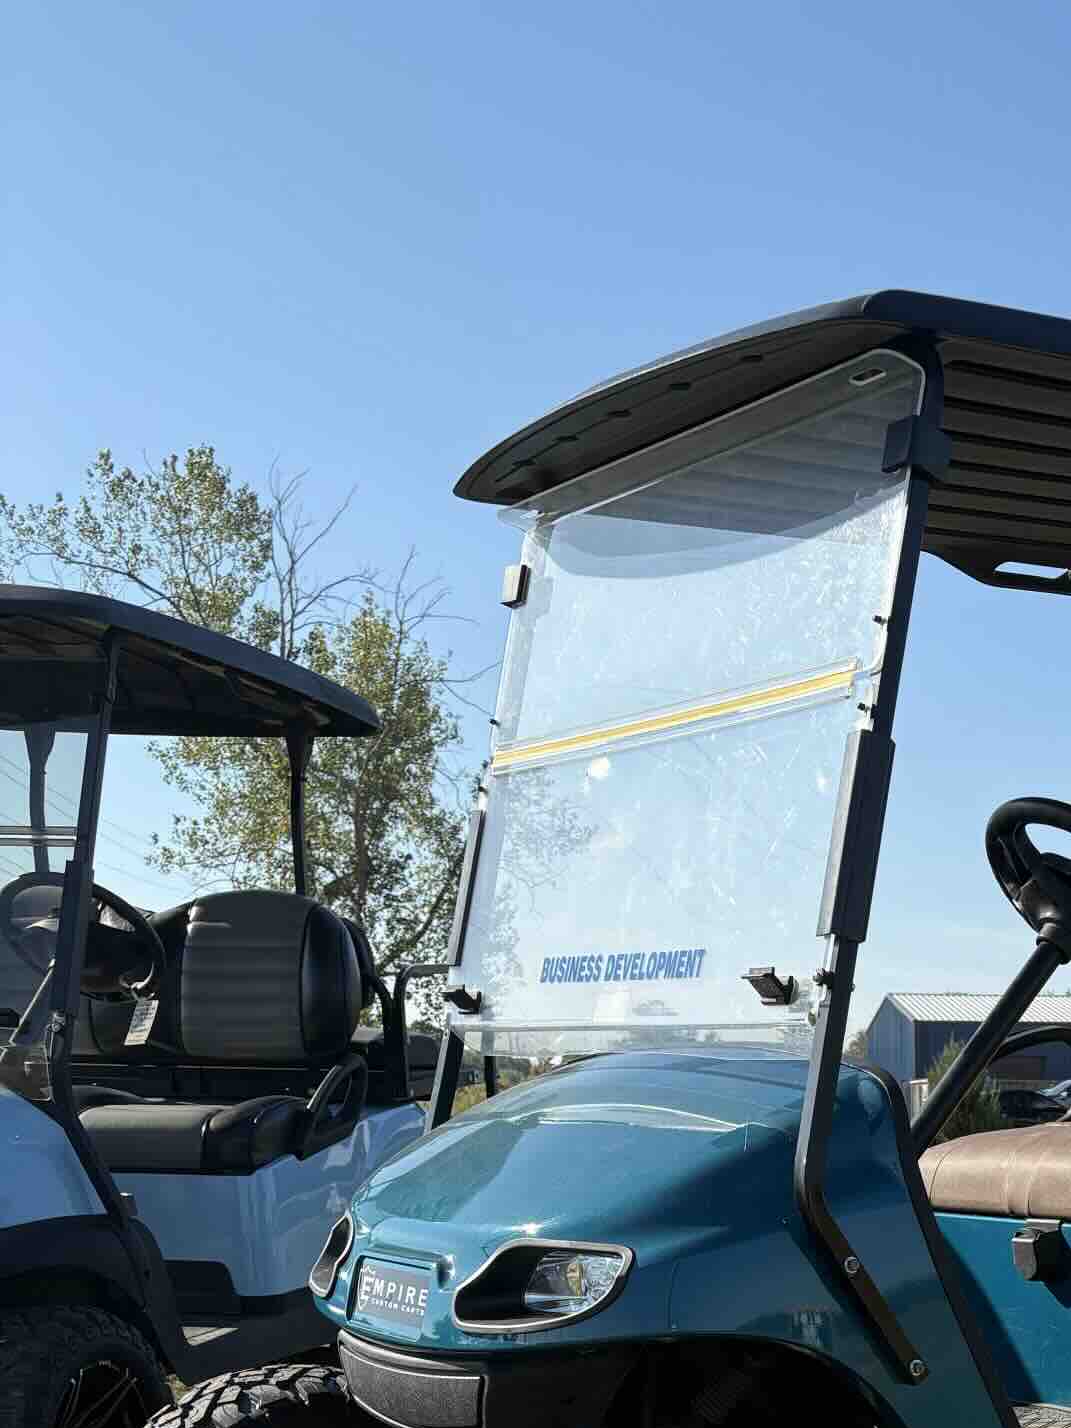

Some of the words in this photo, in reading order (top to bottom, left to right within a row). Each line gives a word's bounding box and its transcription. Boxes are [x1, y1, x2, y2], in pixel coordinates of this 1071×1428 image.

[540, 954, 604, 984] BUSINESS
[603, 949, 707, 982] DEVELOPMENT
[360, 1275, 429, 1307] EMPIRE
[371, 1297, 398, 1309] CUSTOM
[401, 1304, 425, 1316] CARTS
